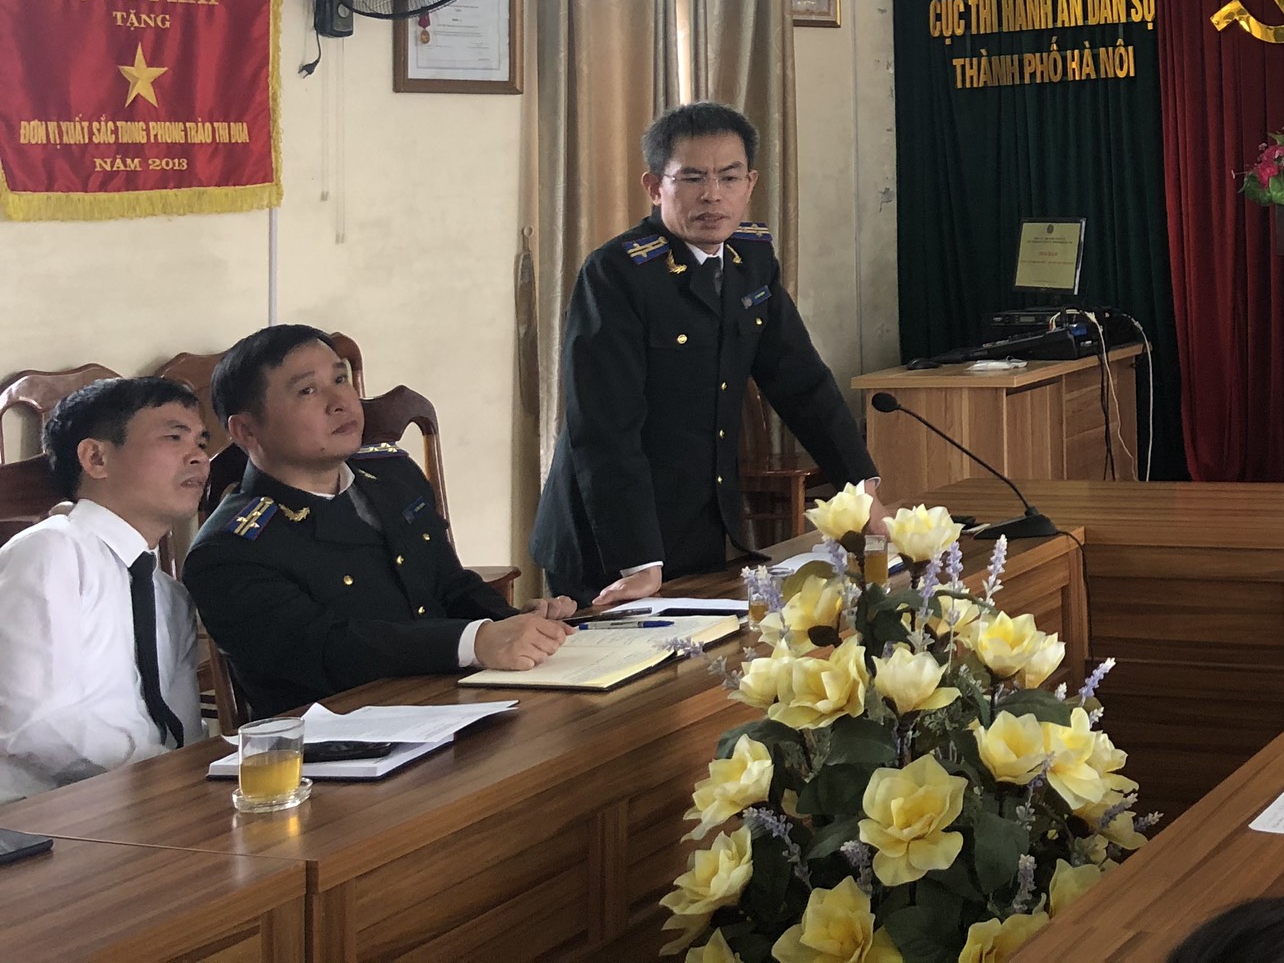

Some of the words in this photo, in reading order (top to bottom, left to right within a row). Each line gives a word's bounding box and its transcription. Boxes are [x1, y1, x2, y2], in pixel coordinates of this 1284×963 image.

[113, 10, 171, 30] TẶNG
[952, 48, 1020, 88] THÀNH
[1023, 36, 1063, 84] PHỐ
[1066, 40, 1097, 81] HÀ
[20, 119, 47, 144] ĐƠN
[47, 121, 60, 149] VỊ
[60, 113, 89, 144] XUẤT
[92, 113, 115, 144] SẮC
[116, 121, 148, 144] TRONG
[148, 121, 185, 144] PHONG
[186, 117, 213, 144] TRÀO
[213, 122, 229, 143] THI
[94, 154, 142, 172] NĂM
[148, 158, 188, 171] 2013
